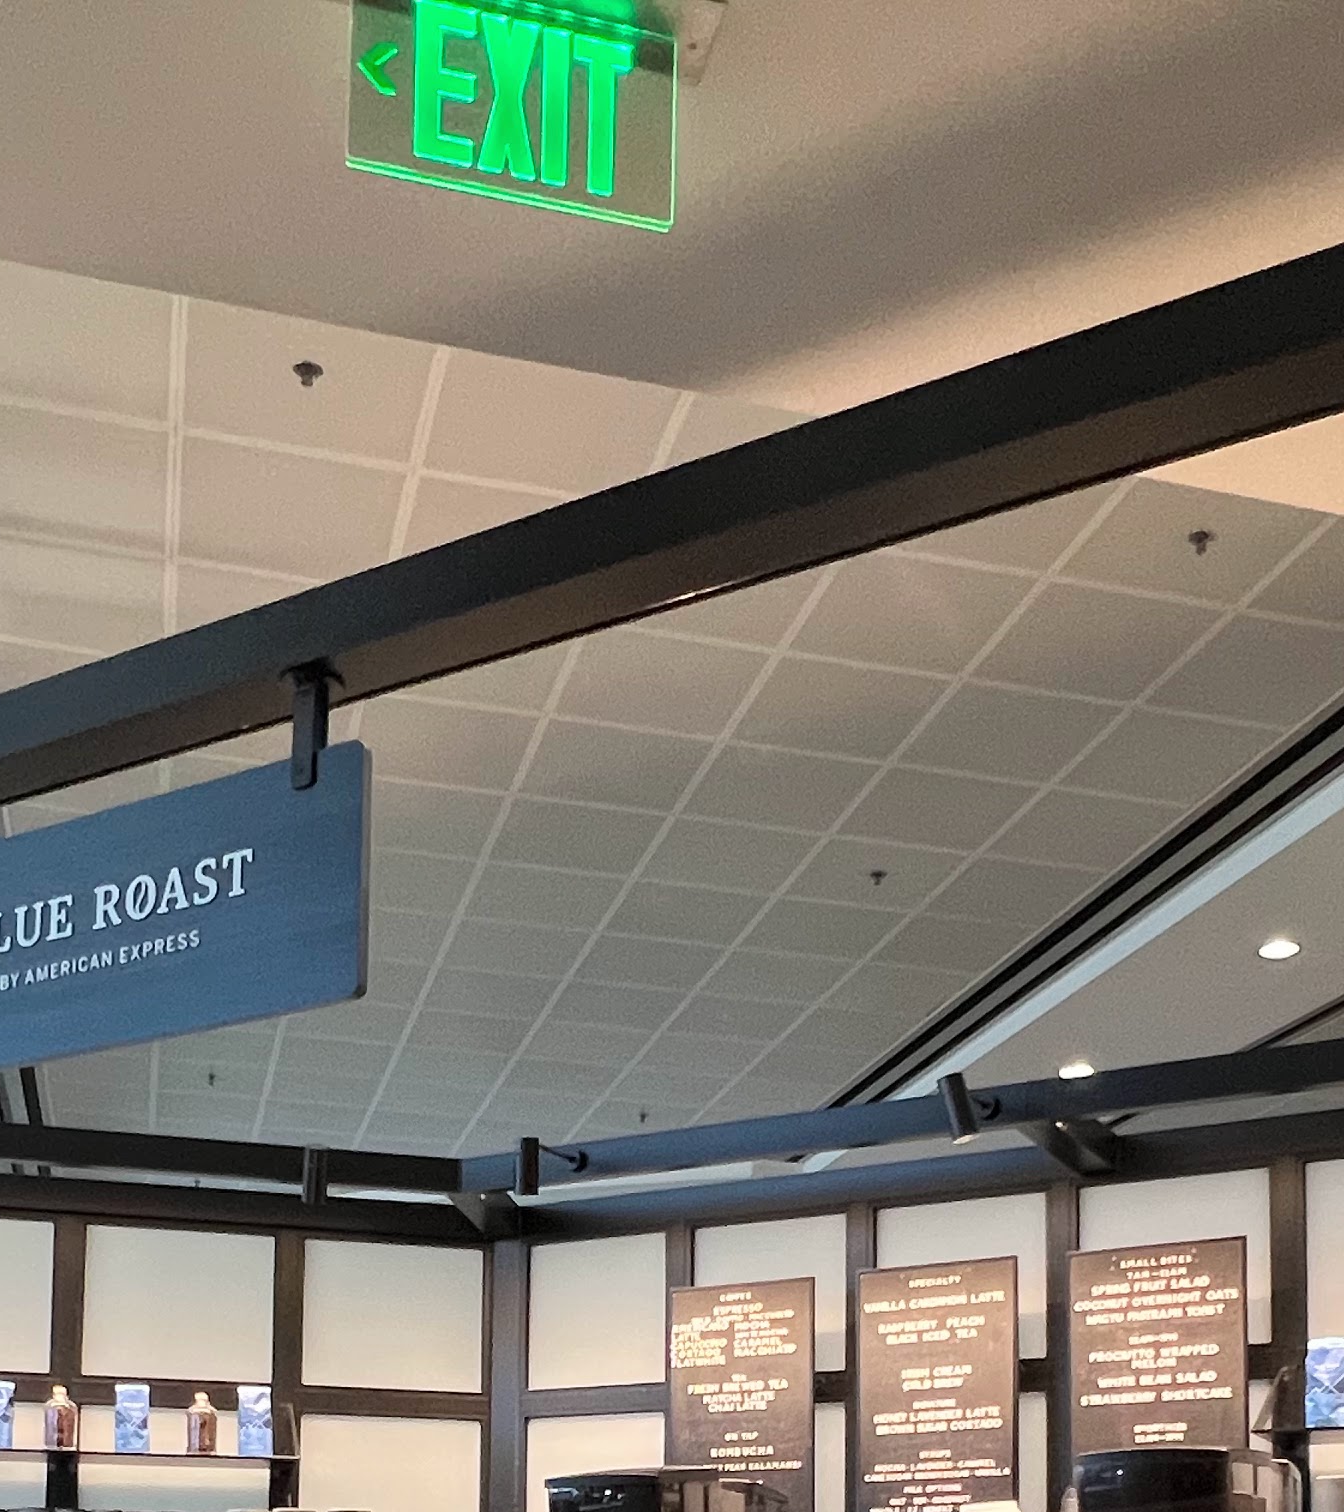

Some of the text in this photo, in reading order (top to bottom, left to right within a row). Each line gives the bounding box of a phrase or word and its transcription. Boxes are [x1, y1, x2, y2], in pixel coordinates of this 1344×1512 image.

[412, 0, 636, 197] EXIT
[23, 949, 113, 986] AMERICAN
[118, 928, 202, 965] EXPRESS
[1119, 1257, 1158, 1270] SMALL
[1133, 1279, 1168, 1293] FRUIT
[1170, 1275, 1211, 1290] SALAD
[970, 1290, 1006, 1304] LATTE
[1073, 1287, 1239, 1312] COCONUT OVERNIGHT OATS
[713, 1302, 763, 1316] ESPRESSO
[946, 1315, 986, 1329] PEACH
[955, 1328, 978, 1339] TEA
[733, 1336, 783, 1349] CARAMEL
[1159, 1343, 1220, 1358] WRAPPED
[1130, 1357, 1178, 1370] MELON
[768, 1378, 789, 1390] TEA
[1175, 1370, 1218, 1384] SALAD
[702, 1390, 776, 1405] MATCHA LATTE
[1080, 1386, 1233, 1407] STRAWBERRY SHORTCAKE
[736, 1401, 768, 1412] LATTE
[965, 1405, 1001, 1419] LATTE
[949, 1418, 1004, 1432] CORTADO
[710, 1445, 774, 1458] KOMBUCHA
